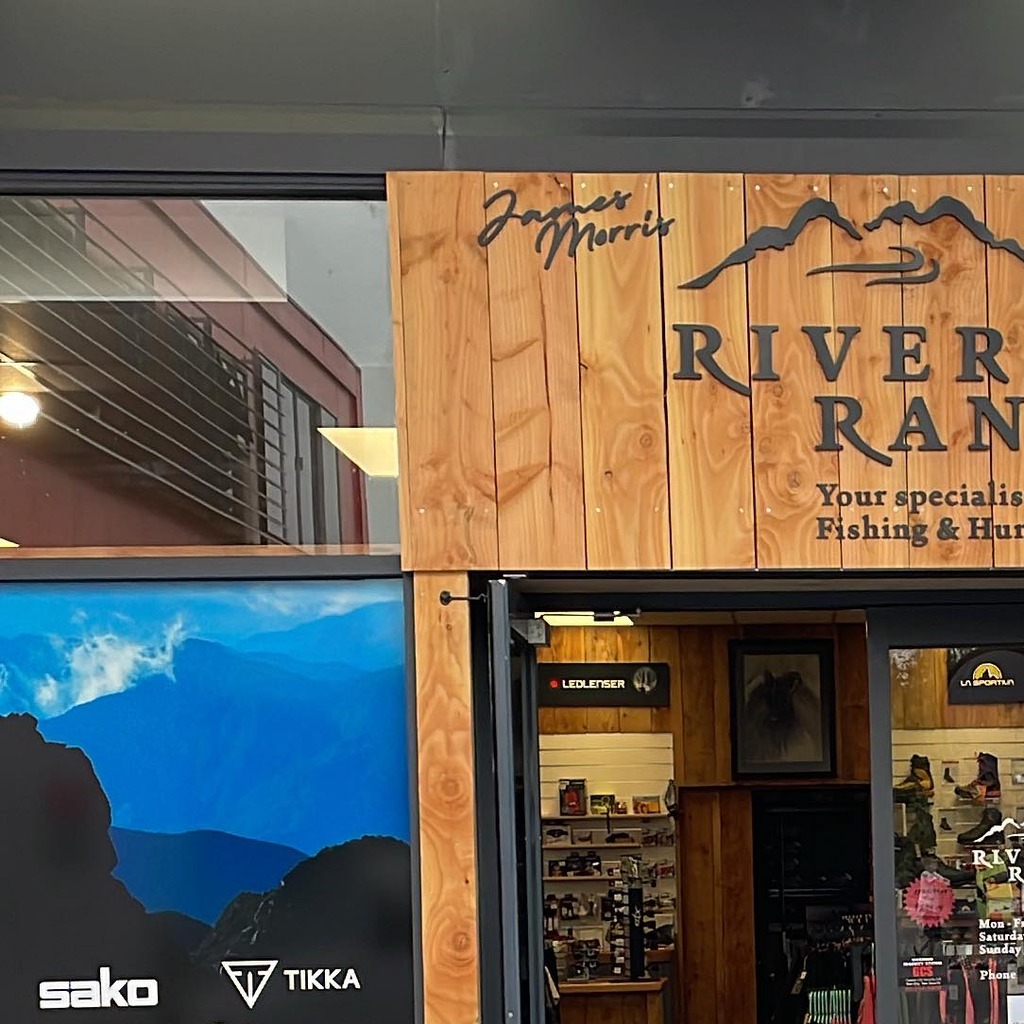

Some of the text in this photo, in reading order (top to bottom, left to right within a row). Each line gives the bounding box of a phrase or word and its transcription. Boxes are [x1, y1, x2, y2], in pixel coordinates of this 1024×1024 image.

[478, 188, 632, 247] James
[535, 210, 676, 270] Morris
[816, 483, 887, 507] Your
[816, 517, 929, 547] Fishing
[936, 517, 960, 541] &
[561, 679, 626, 690] LEDLENSER
[979, 919, 1005, 929] Mon
[979, 943, 1023, 957] Sunday
[283, 968, 361, 991] TIKKA
[980, 969, 1018, 981] Phone
[38, 967, 159, 1010] sako
